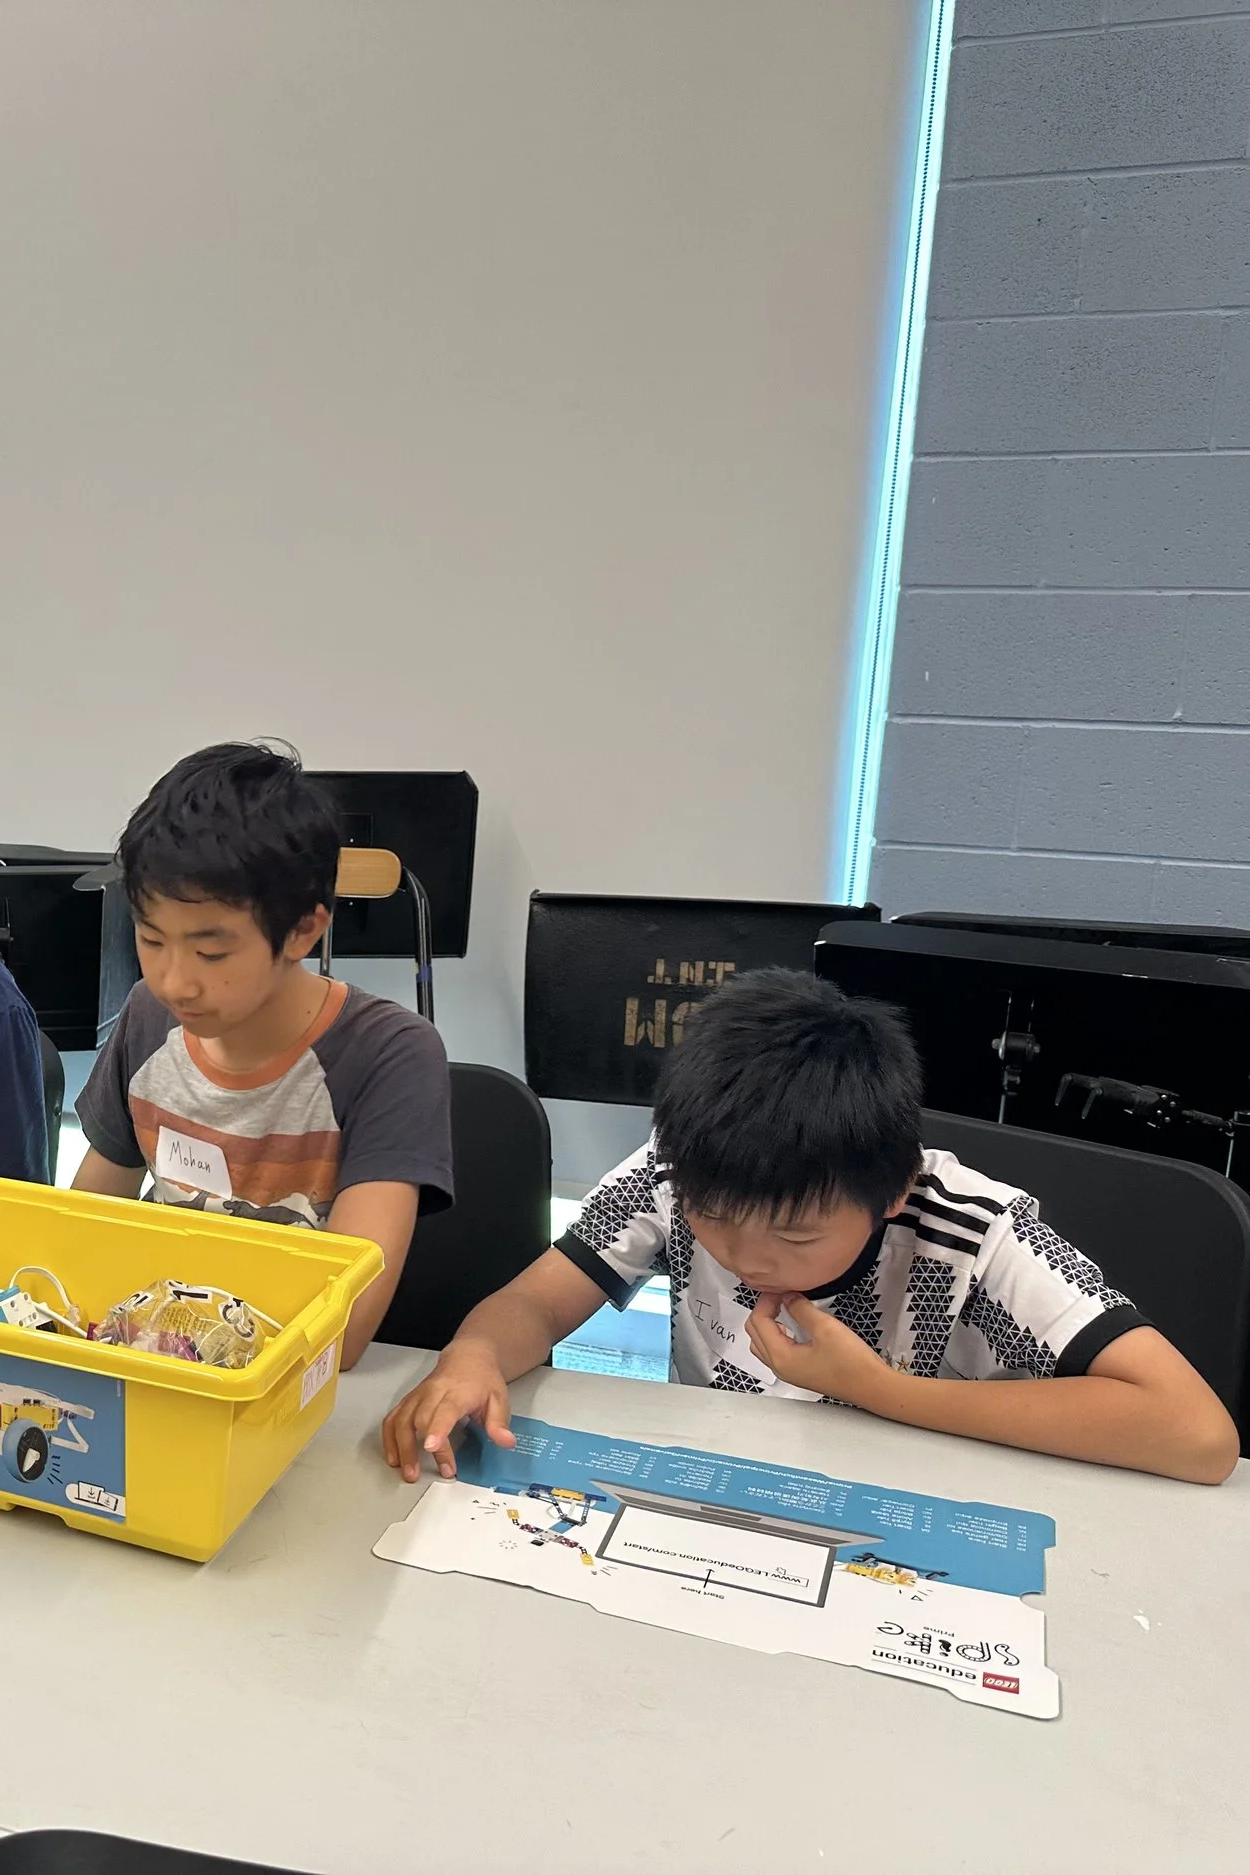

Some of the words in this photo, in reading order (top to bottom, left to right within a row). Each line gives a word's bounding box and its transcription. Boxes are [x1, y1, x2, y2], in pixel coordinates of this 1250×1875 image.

[169, 1140, 211, 1173] Mohan
[694, 1299, 736, 1343] Ivan
[680, 1586, 702, 1595] here
[703, 1590, 726, 1600] Start
[876, 1620, 1020, 1666] spike
[922, 1626, 955, 1638] Prime
[872, 1649, 977, 1680] education
[983, 1674, 1019, 1692] LEGO
